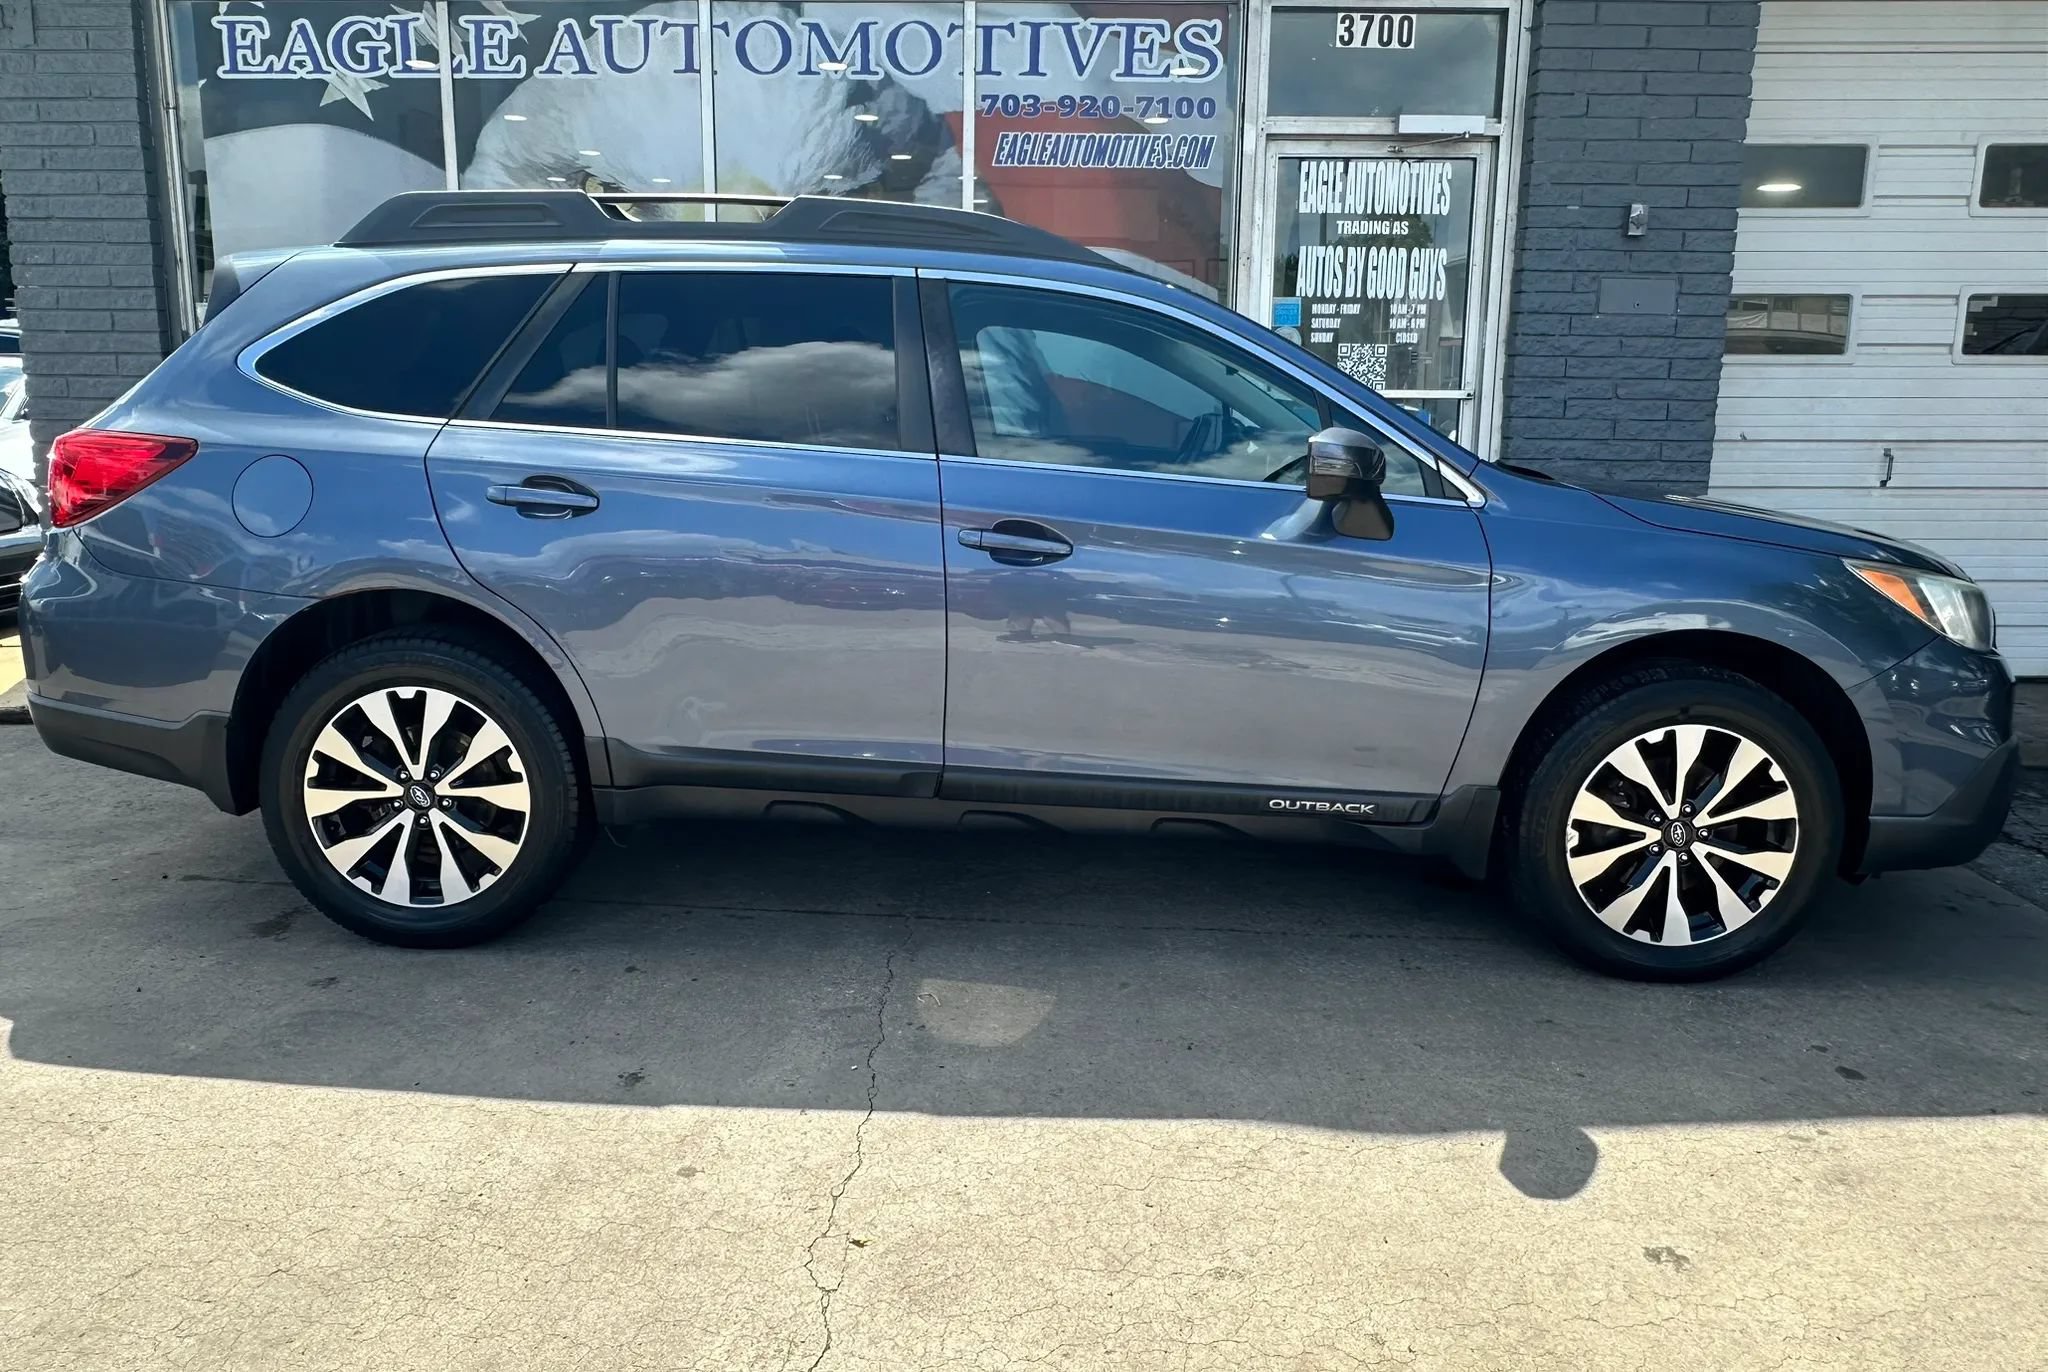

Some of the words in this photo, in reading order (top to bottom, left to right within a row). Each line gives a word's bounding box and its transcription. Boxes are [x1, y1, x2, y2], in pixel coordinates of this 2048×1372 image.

[1338, 13, 1414, 48] 3700
[213, 15, 527, 80] EAGLE
[534, 15, 1223, 82] AUTOMOTIVES
[980, 93, 1217, 120] 703-920-7100
[991, 133, 1217, 169] EAGLEAUTOMOTIVES.COM
[1299, 160, 1344, 214] EAGLE
[1345, 161, 1452, 215] AUTOMOTIVES
[1336, 221, 1390, 234] TRADING
[1392, 221, 1409, 235] AS
[1296, 246, 1344, 298] AUTOS
[1345, 247, 1366, 298] BY
[1366, 247, 1407, 300] GOOD
[1408, 248, 1447, 300] GUYS
[1311, 303, 1336, 314] MONDAY
[1340, 303, 1360, 314] FRIDAY
[1311, 318, 1341, 329] SATURDAY
[1310, 332, 1334, 343] SUNDAY
[1395, 332, 1418, 343] CLOSED
[1269, 799, 1375, 814] OUTBACK
